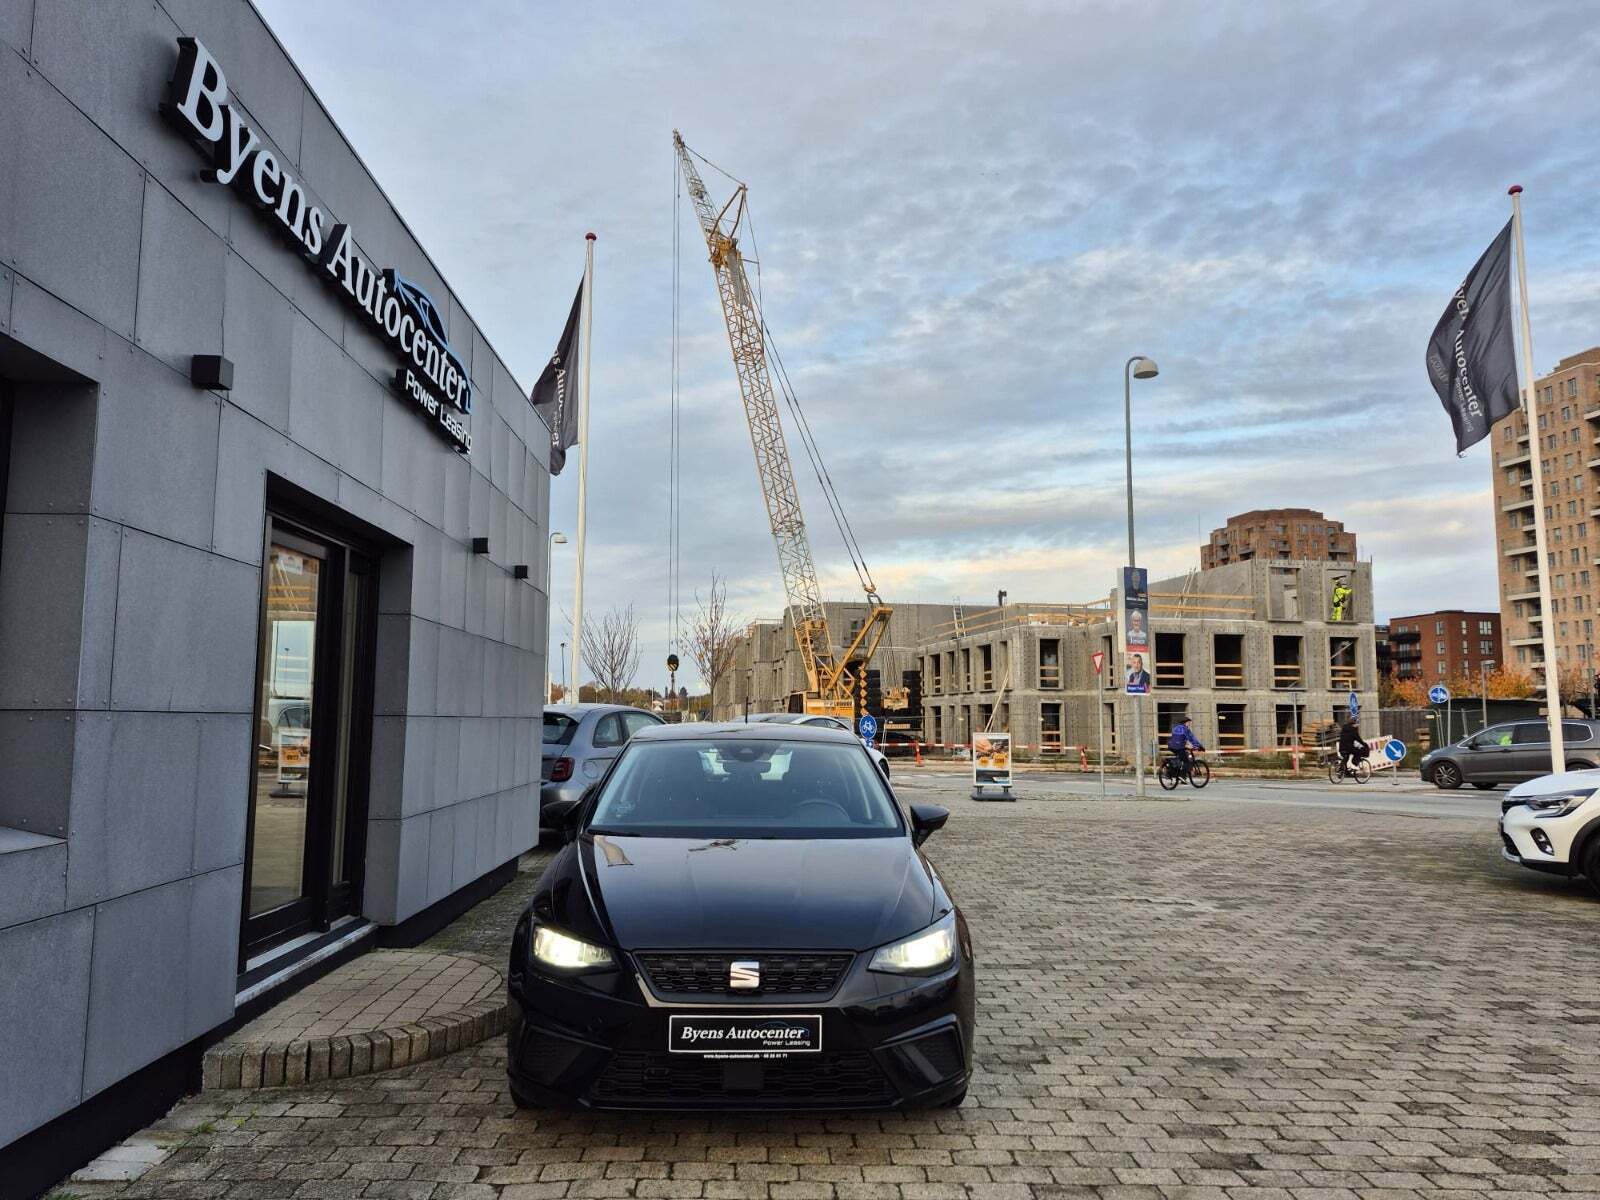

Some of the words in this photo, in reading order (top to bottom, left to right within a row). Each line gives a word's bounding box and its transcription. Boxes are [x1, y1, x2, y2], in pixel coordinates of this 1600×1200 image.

[177, 37, 326, 256] Byens
[326, 225, 467, 410] Autocenter
[405, 369, 439, 416] Power
[440, 403, 472, 455] Leasing
[681, 1026, 723, 1042] Byens
[726, 1026, 804, 1038] Autocenter
